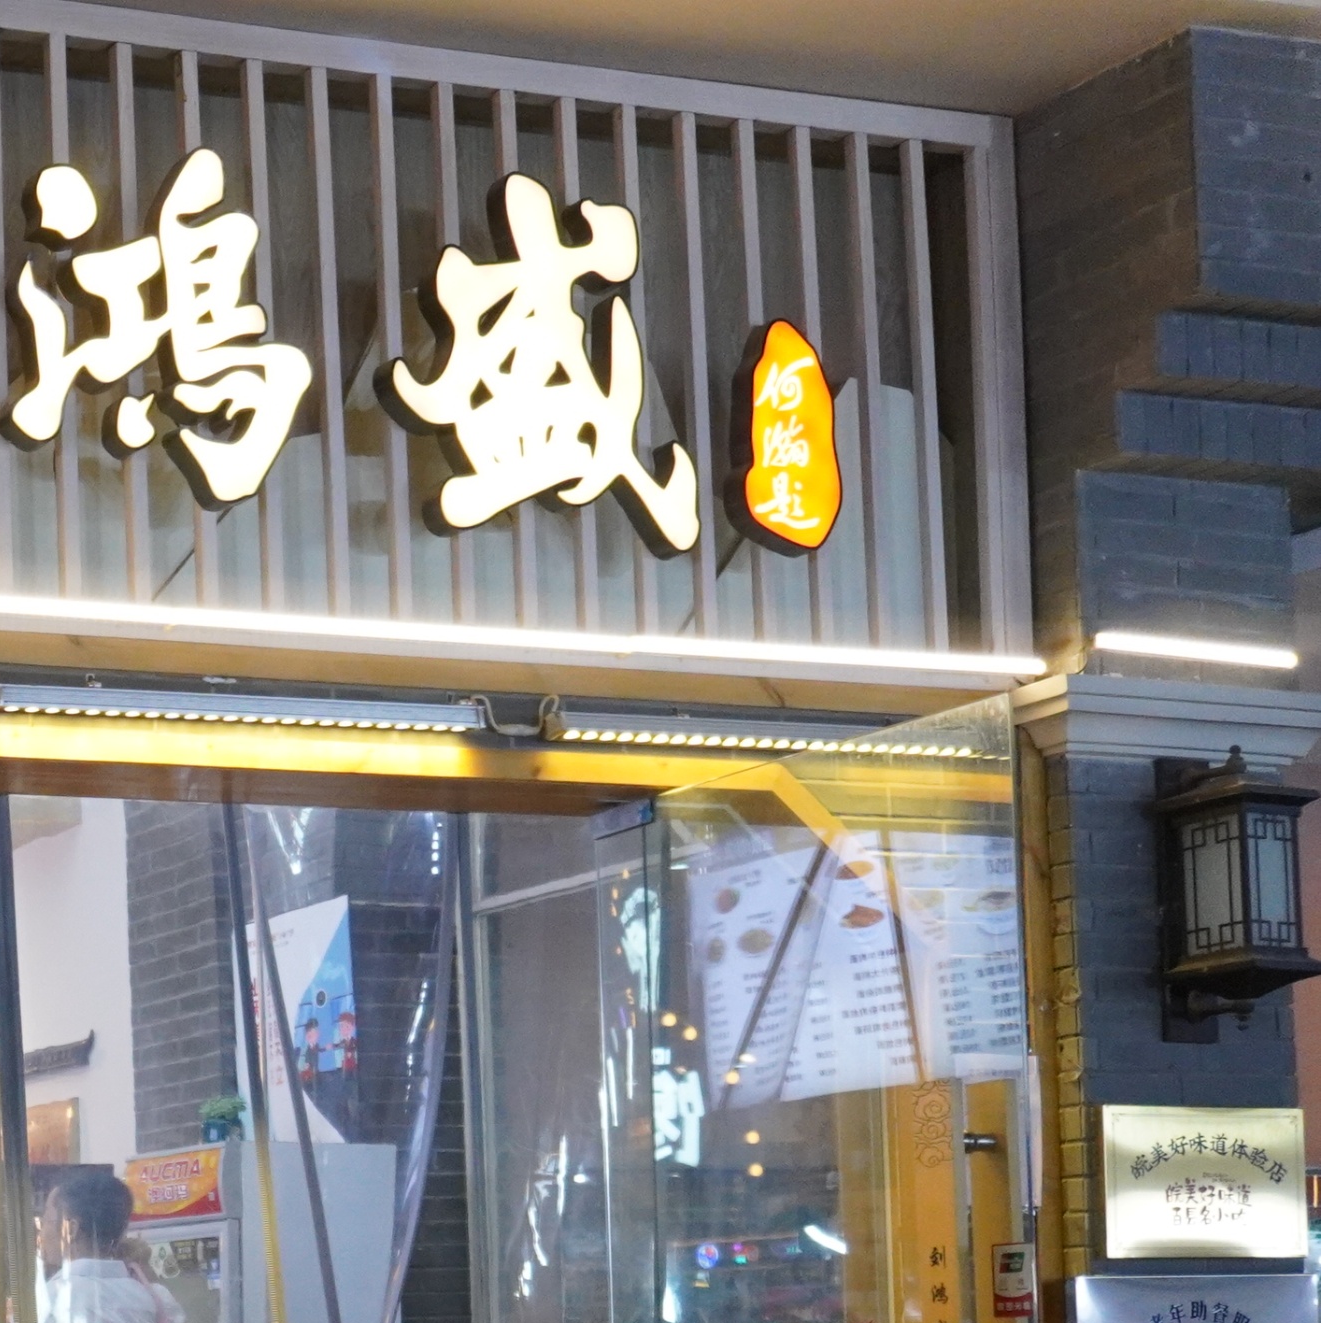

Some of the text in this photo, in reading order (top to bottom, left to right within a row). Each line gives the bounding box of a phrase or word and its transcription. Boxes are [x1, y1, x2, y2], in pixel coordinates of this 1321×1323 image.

[139, 1159, 202, 1183] AUCMA
[1130, 1132, 1288, 1185] 皖美好味道体验店
